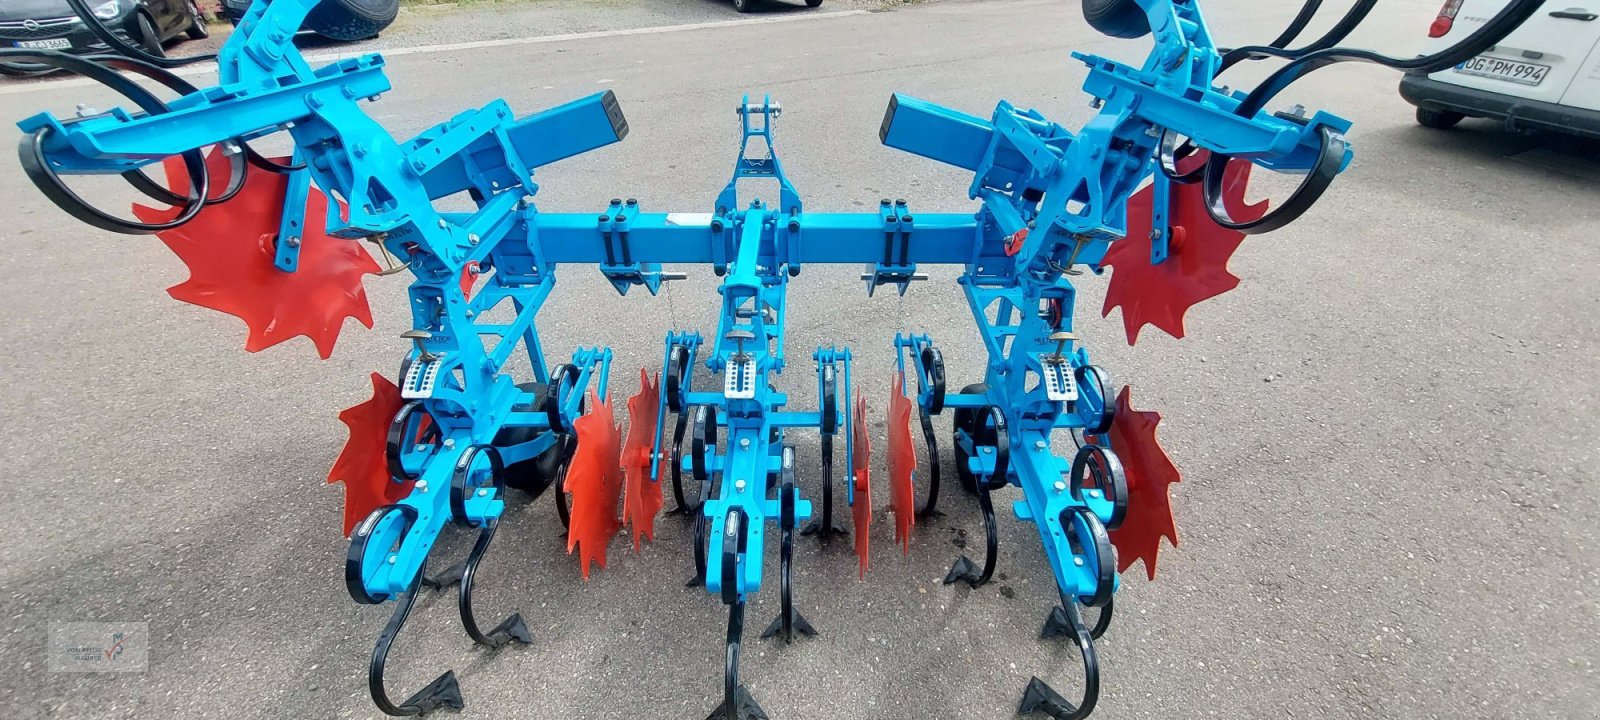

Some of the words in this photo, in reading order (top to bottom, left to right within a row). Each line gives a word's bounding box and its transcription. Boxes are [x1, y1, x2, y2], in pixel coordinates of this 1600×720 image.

[1465, 58, 1487, 71] OG
[1492, 61, 1515, 75] PM
[1513, 65, 1545, 80] 994
